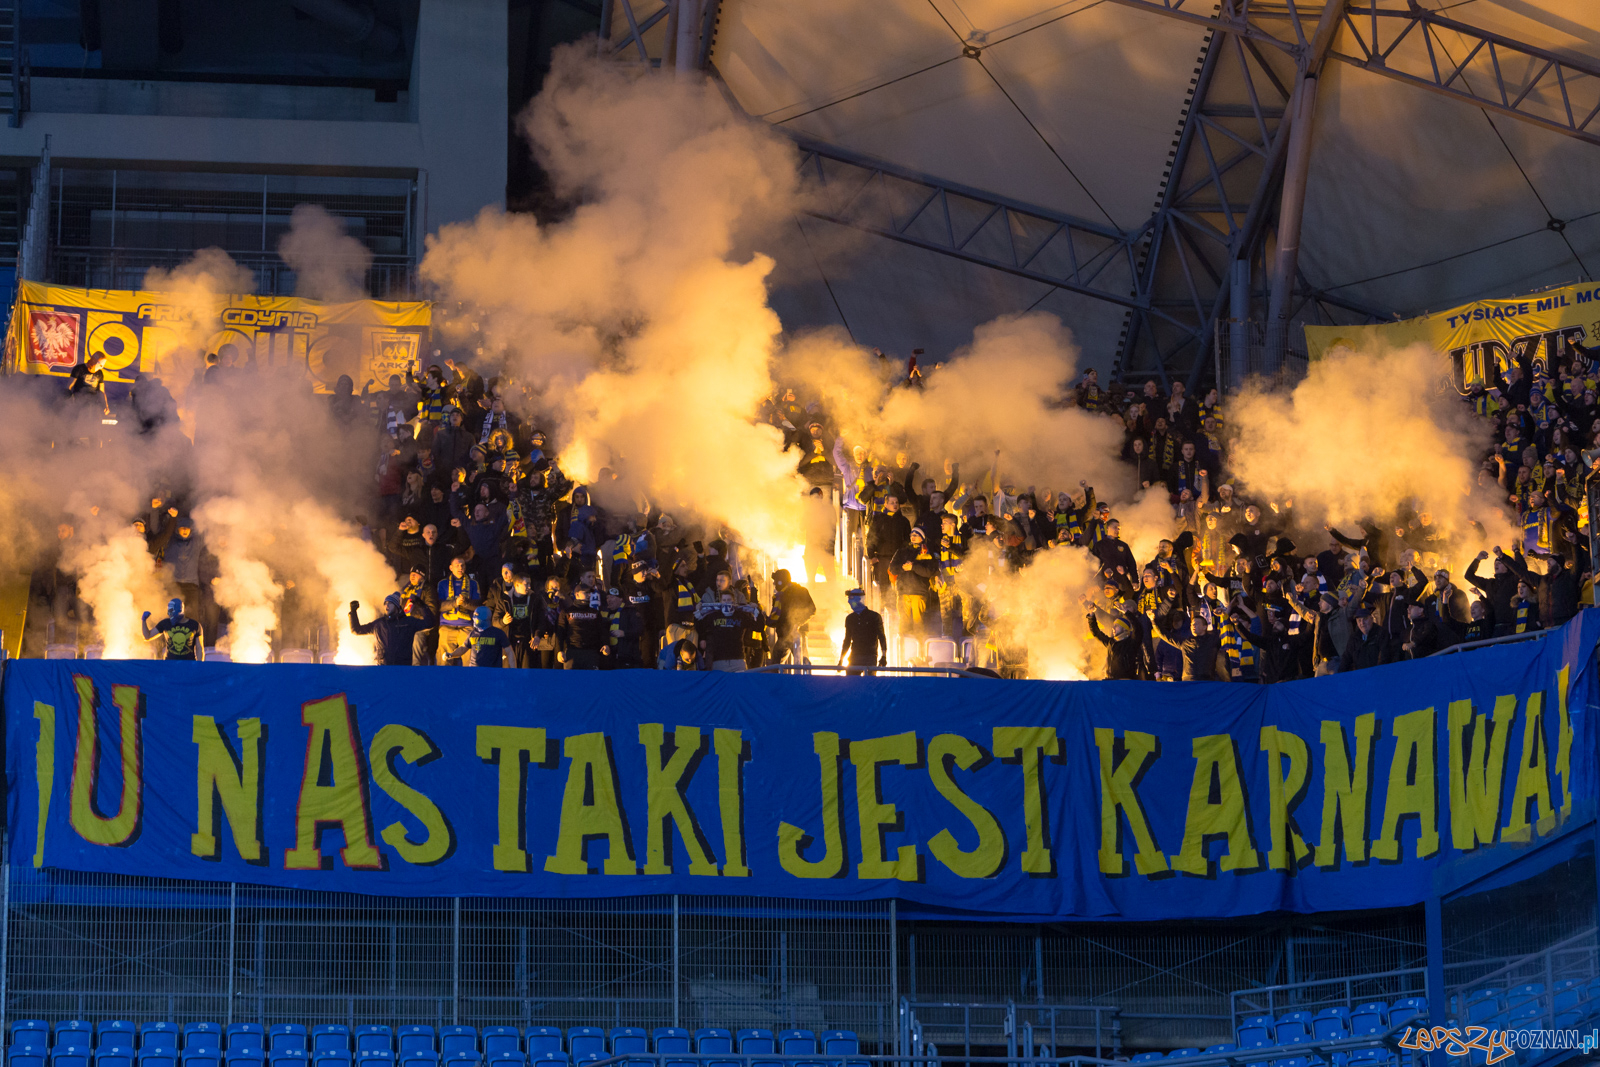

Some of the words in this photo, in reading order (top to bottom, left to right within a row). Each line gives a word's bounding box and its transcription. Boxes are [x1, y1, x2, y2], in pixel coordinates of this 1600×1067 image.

[1446, 302, 1530, 328] TYSIĄCE
[1536, 295, 1571, 312] MIL
[69, 672, 147, 848] U
[191, 693, 457, 872] NAS
[476, 722, 753, 878] TAKI
[777, 726, 1067, 882] JEST
